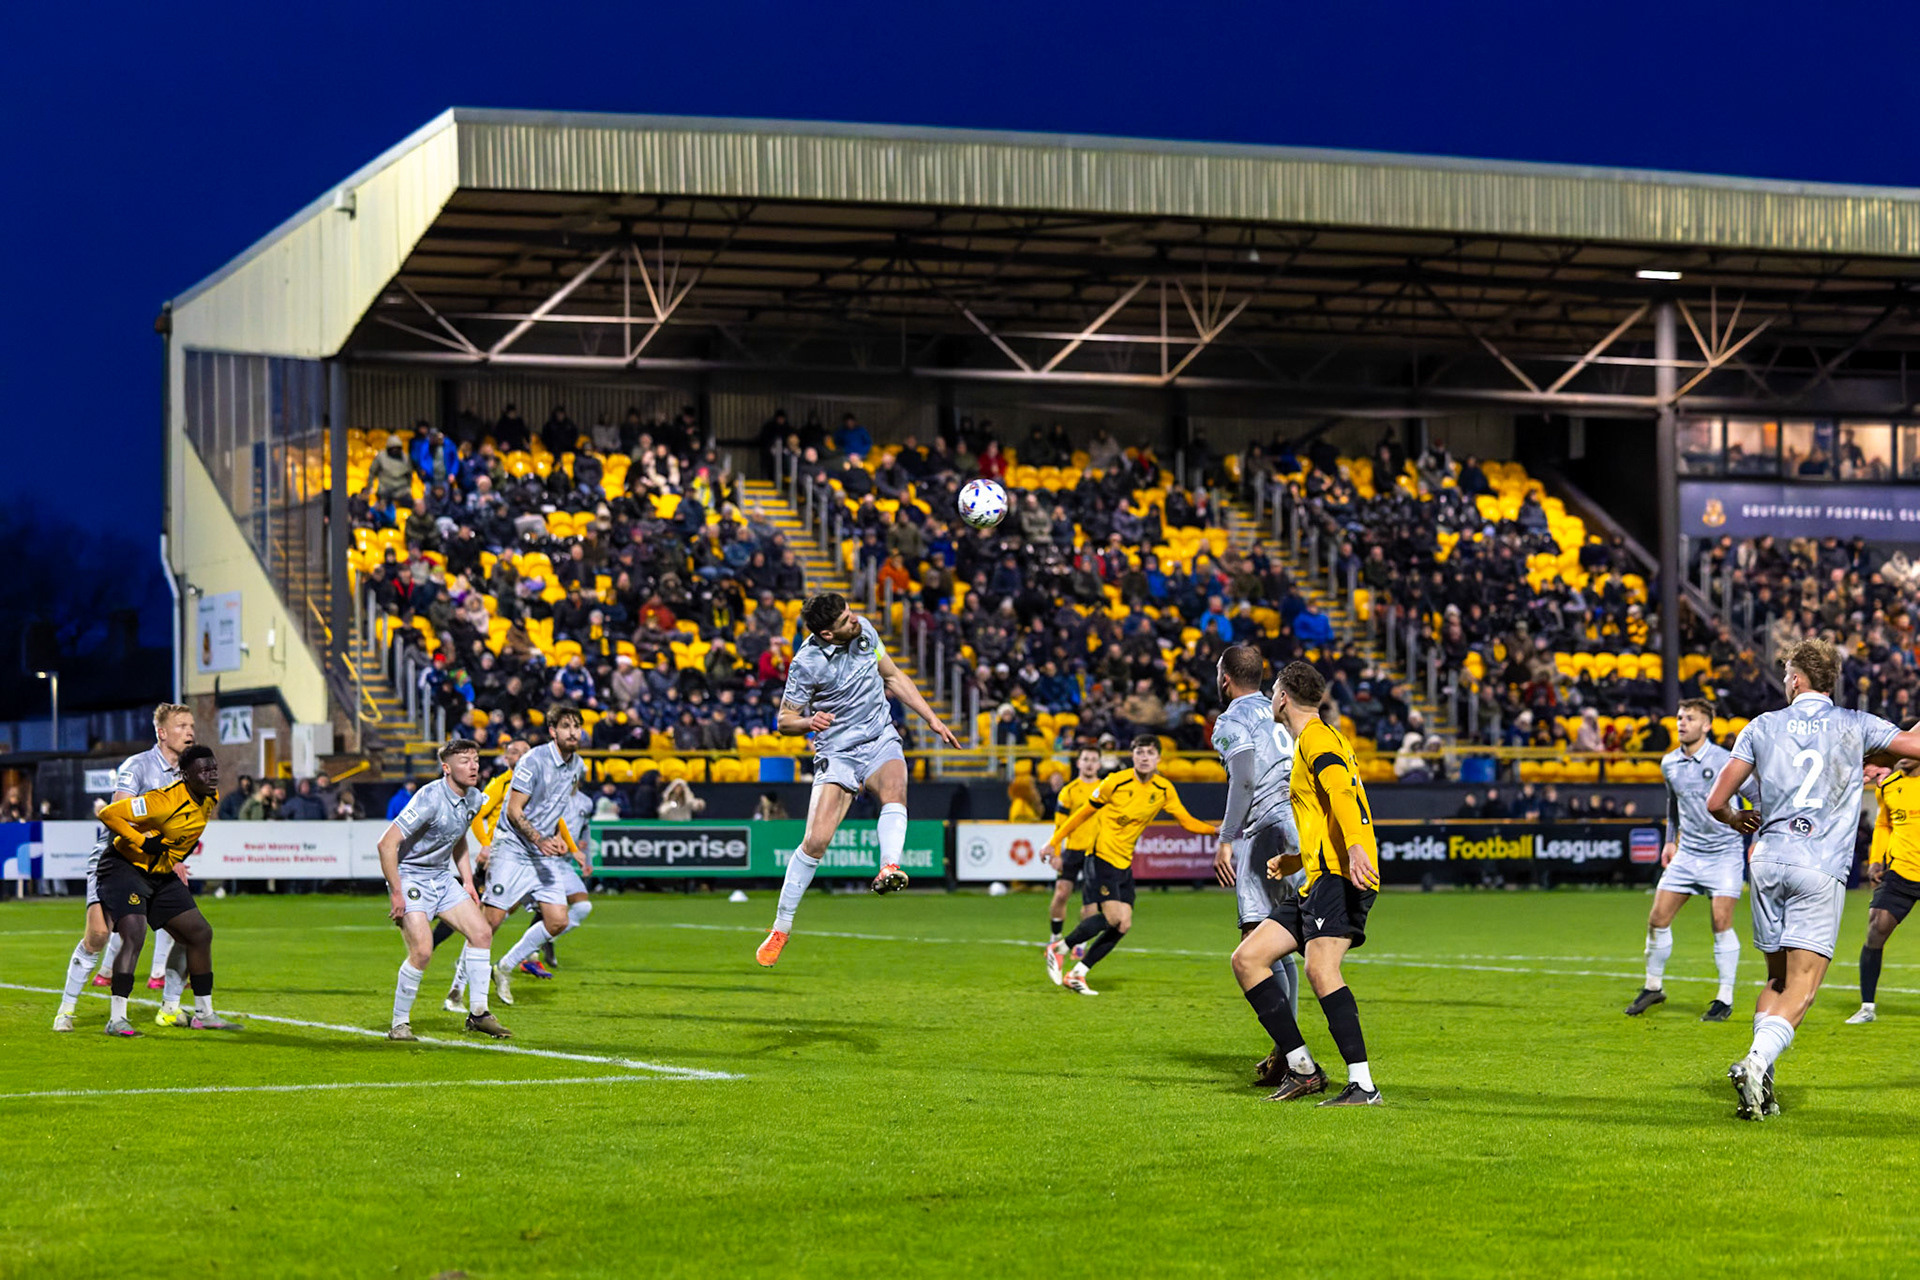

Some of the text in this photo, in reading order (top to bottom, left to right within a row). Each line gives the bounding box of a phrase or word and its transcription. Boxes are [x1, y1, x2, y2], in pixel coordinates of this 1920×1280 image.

[1742, 504, 1820, 519] SOUTHPORT
[1826, 506, 1893, 520] FOOTBALL
[1787, 718, 1830, 736] GRIST
[1792, 749, 1824, 809] 2
[244, 842, 266, 851] Real
[268, 842, 300, 852] Money
[829, 829, 878, 847] ERE FO
[774, 849, 933, 867] TH TIONAL AGUE
[1448, 835, 1533, 861] Football
[1535, 834, 1622, 864] Leagues
[293, 855, 337, 863] Referrals
